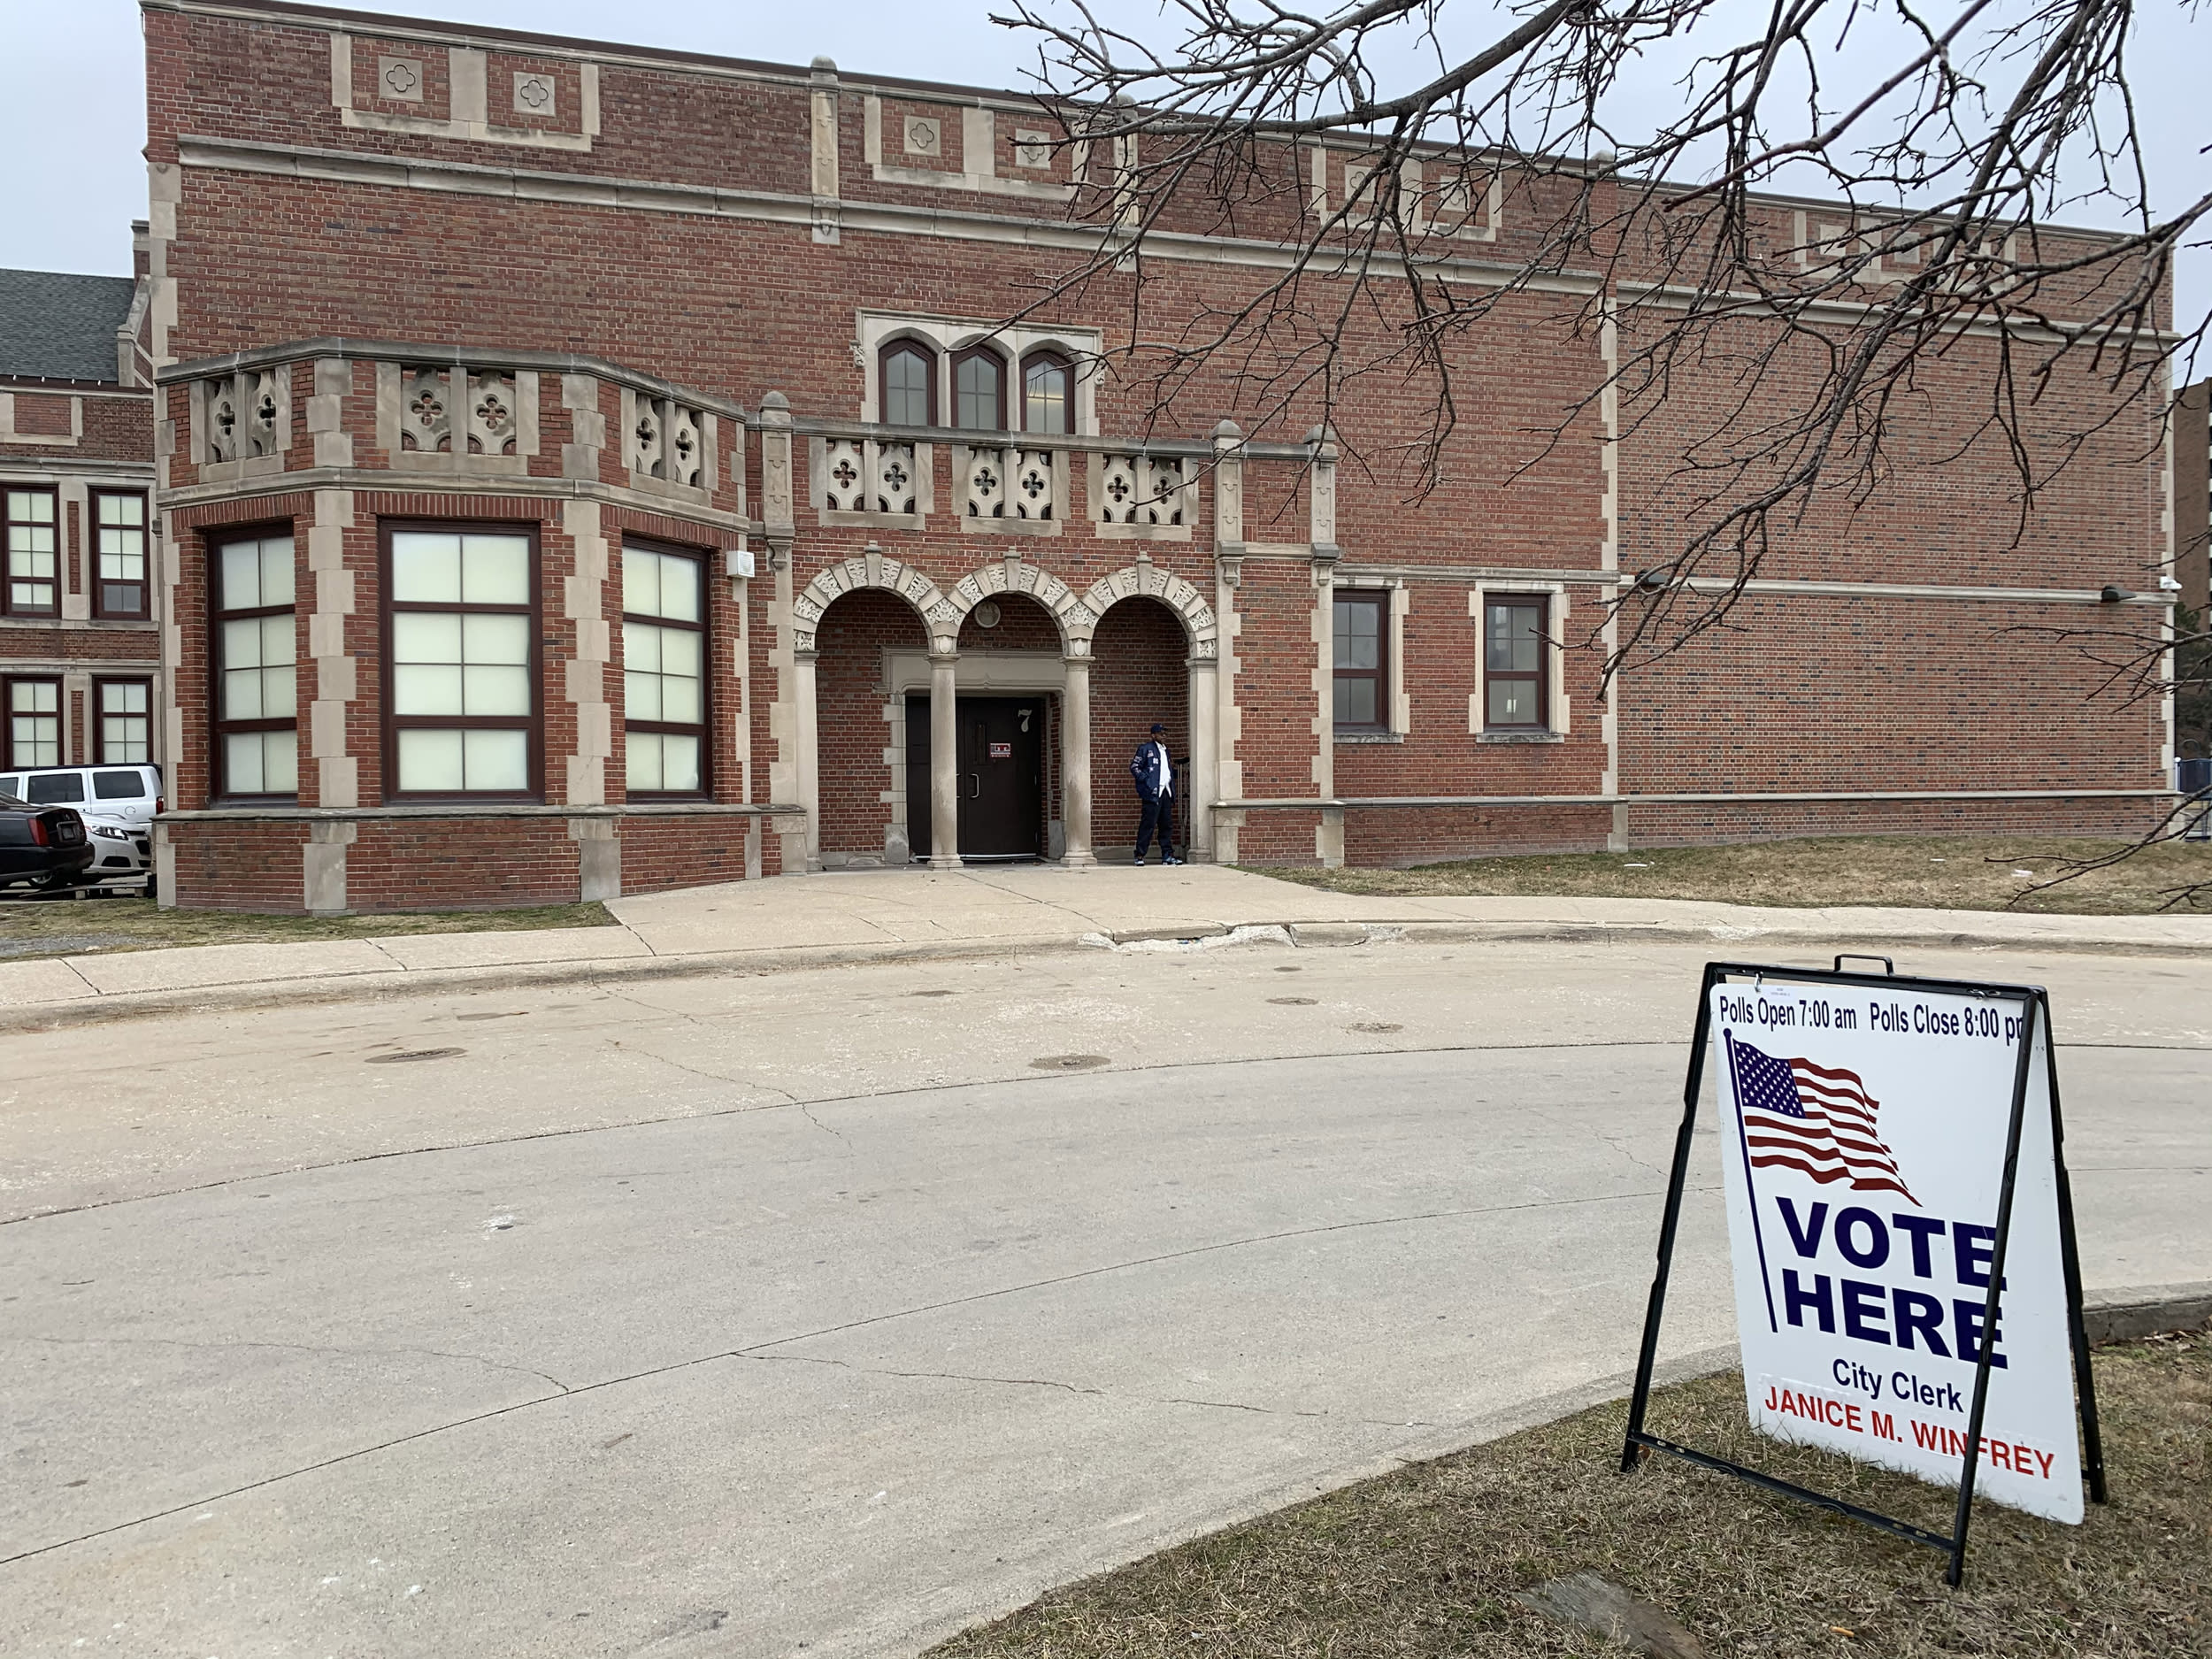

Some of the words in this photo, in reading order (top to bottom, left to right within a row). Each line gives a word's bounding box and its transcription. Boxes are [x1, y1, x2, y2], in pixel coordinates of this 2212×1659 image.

[1018, 709, 1032, 733] 7
[1720, 996, 1754, 1023] Polls
[1758, 997, 1795, 1032] Open
[1800, 1000, 1829, 1027] 7:00
[1835, 1009, 1856, 1029] am
[1870, 1002, 1909, 1033] Polls
[1914, 1004, 1959, 1035] Close
[1964, 1007, 1999, 1038] 8:00
[1775, 1196, 2008, 1291] VOTE
[1781, 1268, 2008, 1370] HERE
[1833, 1359, 1882, 1399] City
[1892, 1371, 1963, 1413] Clerk
[1766, 1387, 1863, 1432] JANICE
[1872, 1411, 1902, 1441] M.
